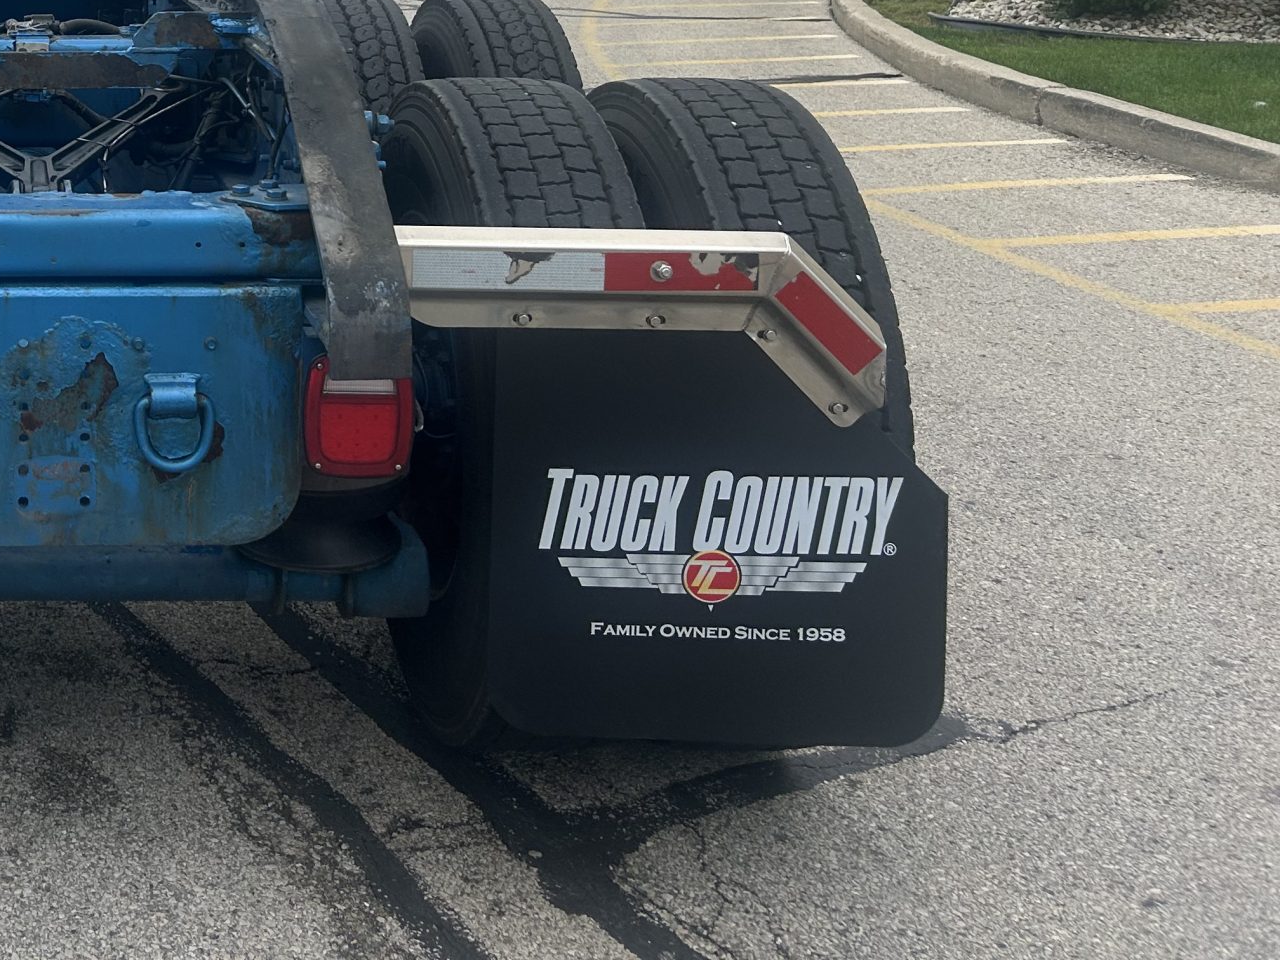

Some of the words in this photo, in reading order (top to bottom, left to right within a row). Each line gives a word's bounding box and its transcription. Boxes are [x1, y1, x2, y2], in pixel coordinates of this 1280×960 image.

[538, 468, 691, 552] TRUCK
[692, 470, 905, 555] COUNTRY
[590, 622, 657, 637] FAMILY
[659, 623, 731, 640] OWNED
[733, 625, 791, 642] SINCE
[797, 627, 847, 642] 1958
